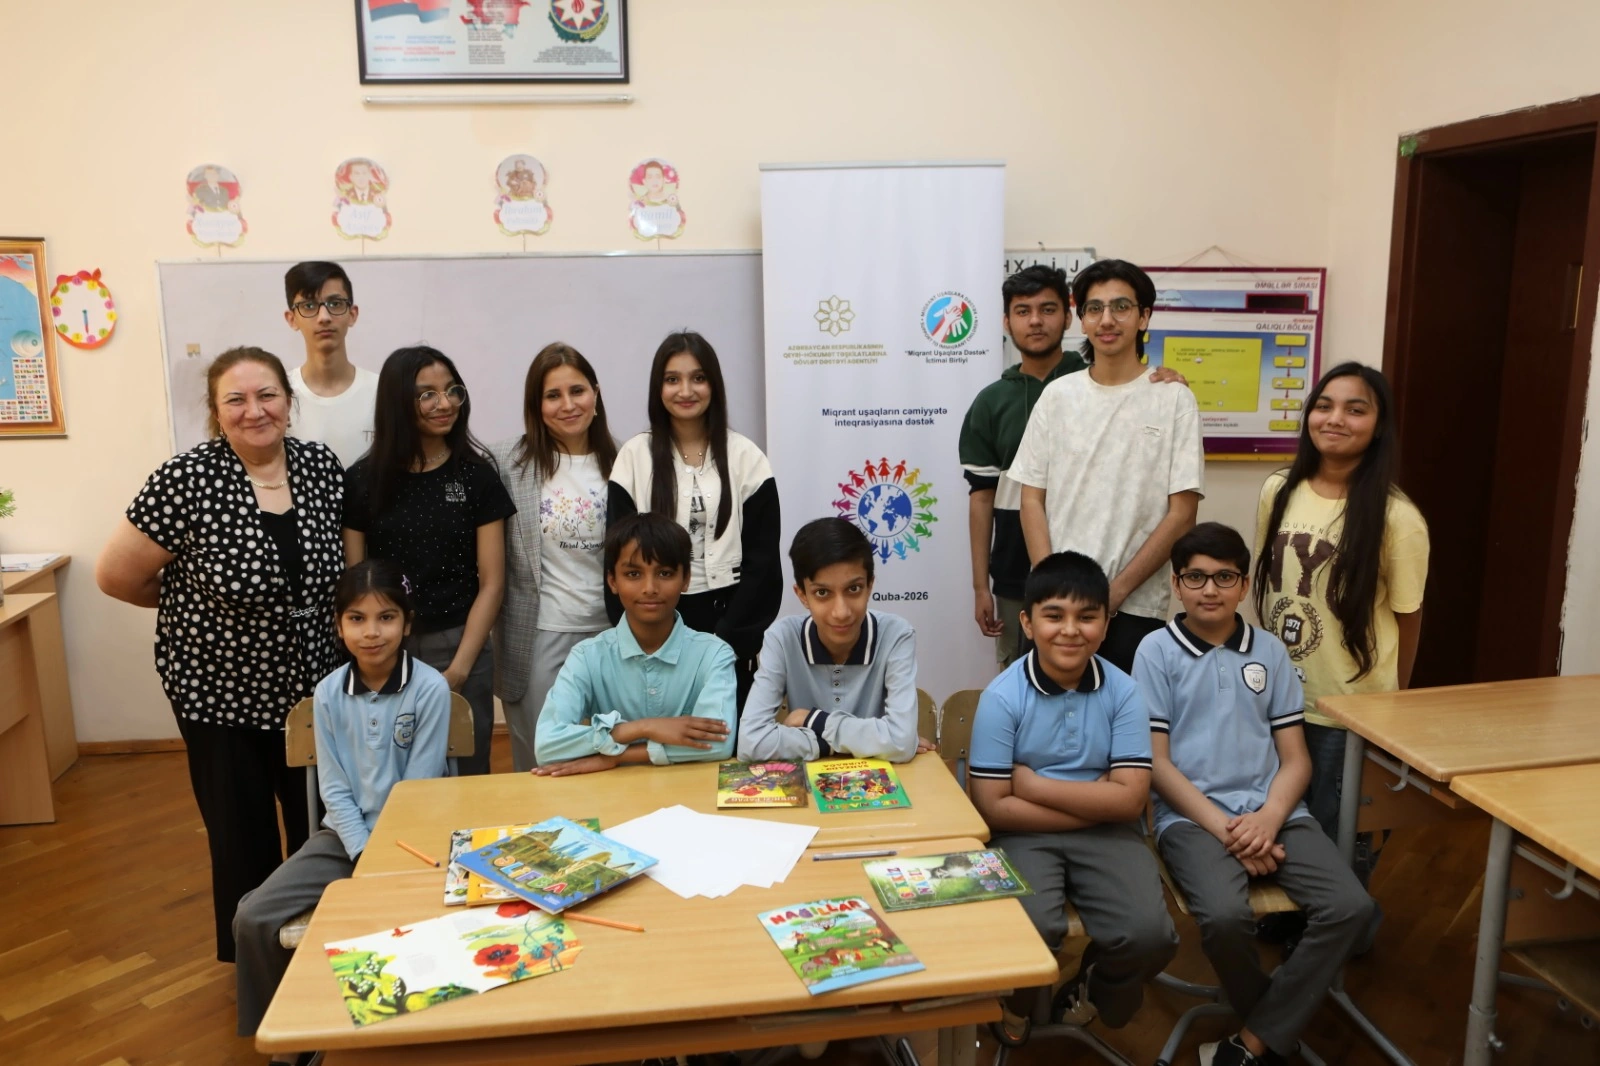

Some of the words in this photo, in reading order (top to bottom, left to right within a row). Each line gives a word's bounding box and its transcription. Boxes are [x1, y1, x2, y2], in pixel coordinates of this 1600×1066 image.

[1070, 259, 1079, 273] J
[948, 356, 969, 364] Birliyi
[822, 408, 856, 418] Miqrant
[858, 407, 900, 418] uşaqların
[902, 406, 948, 417] cəmiyyətə
[834, 418, 903, 428] inteqrasiyasına
[905, 417, 935, 426] dəstək
[872, 591, 929, 602] Quba-2026
